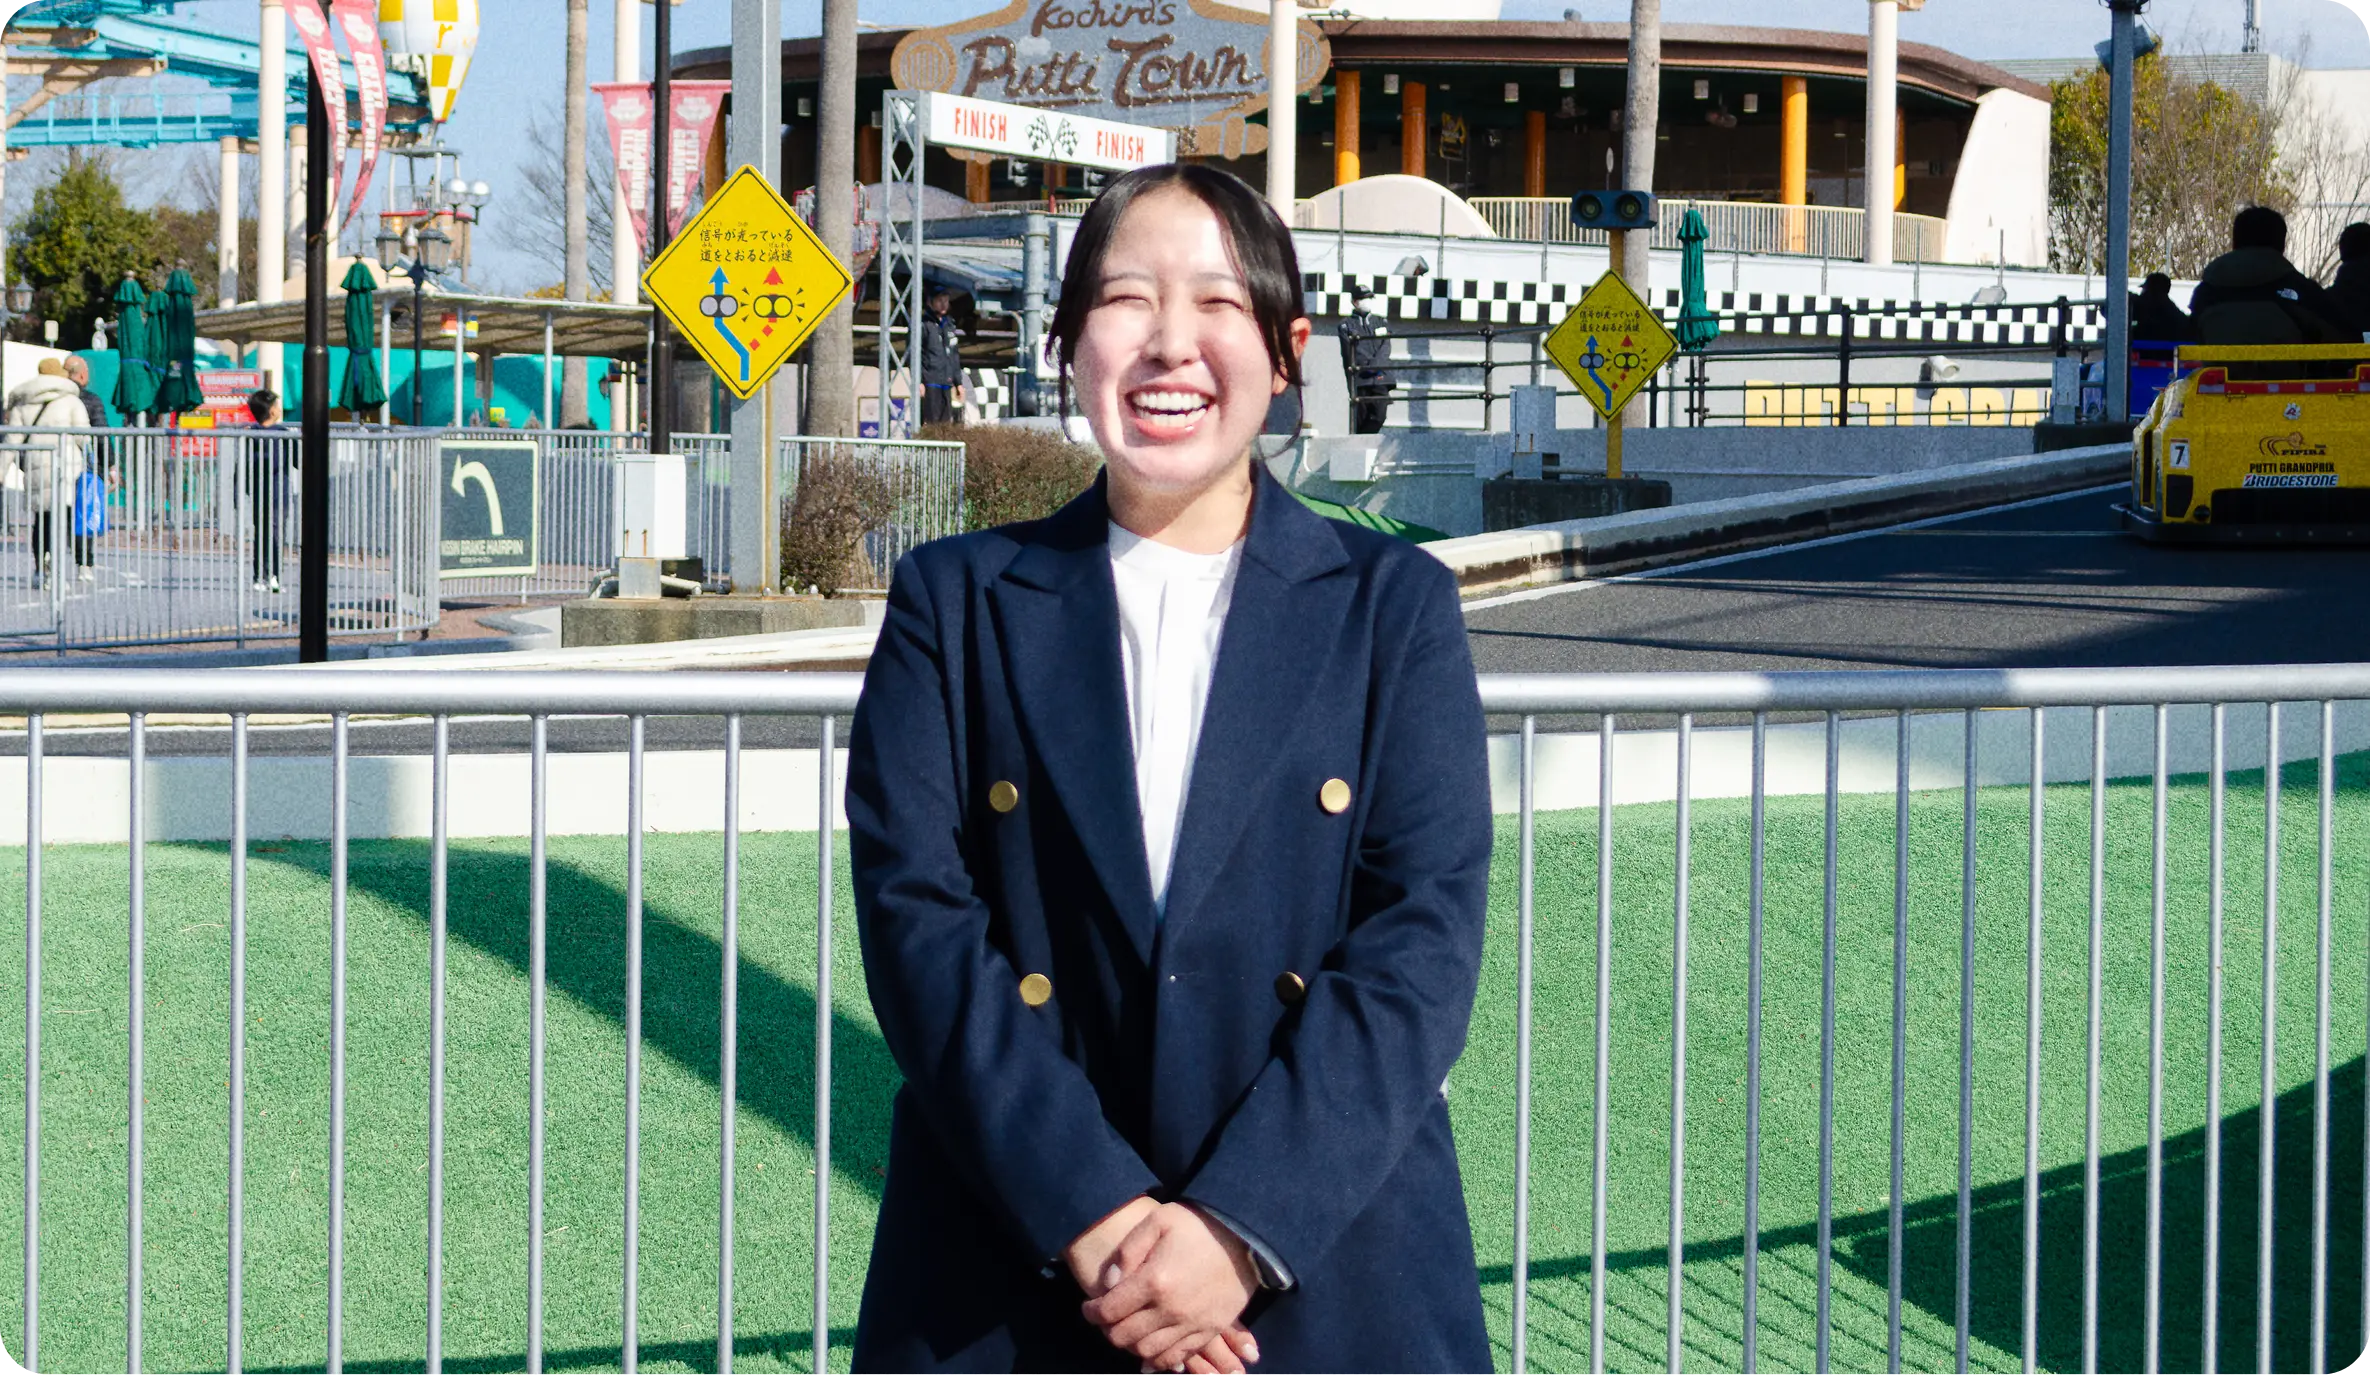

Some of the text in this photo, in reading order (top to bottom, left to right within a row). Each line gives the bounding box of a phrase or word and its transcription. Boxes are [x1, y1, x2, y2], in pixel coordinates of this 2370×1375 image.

[962, 33, 1267, 107] Putti Town
[954, 107, 1145, 163] FINISH FINISH
[700, 228, 793, 242] 信号が光っている
[700, 249, 793, 262] 道をとおると減速
[2174, 445, 2186, 465] 7
[2250, 462, 2335, 473] PUTTI GRANDPRIX
[2244, 474, 2338, 487] BRIDGESTONE
[487, 539, 523, 555] HAIRPIN
